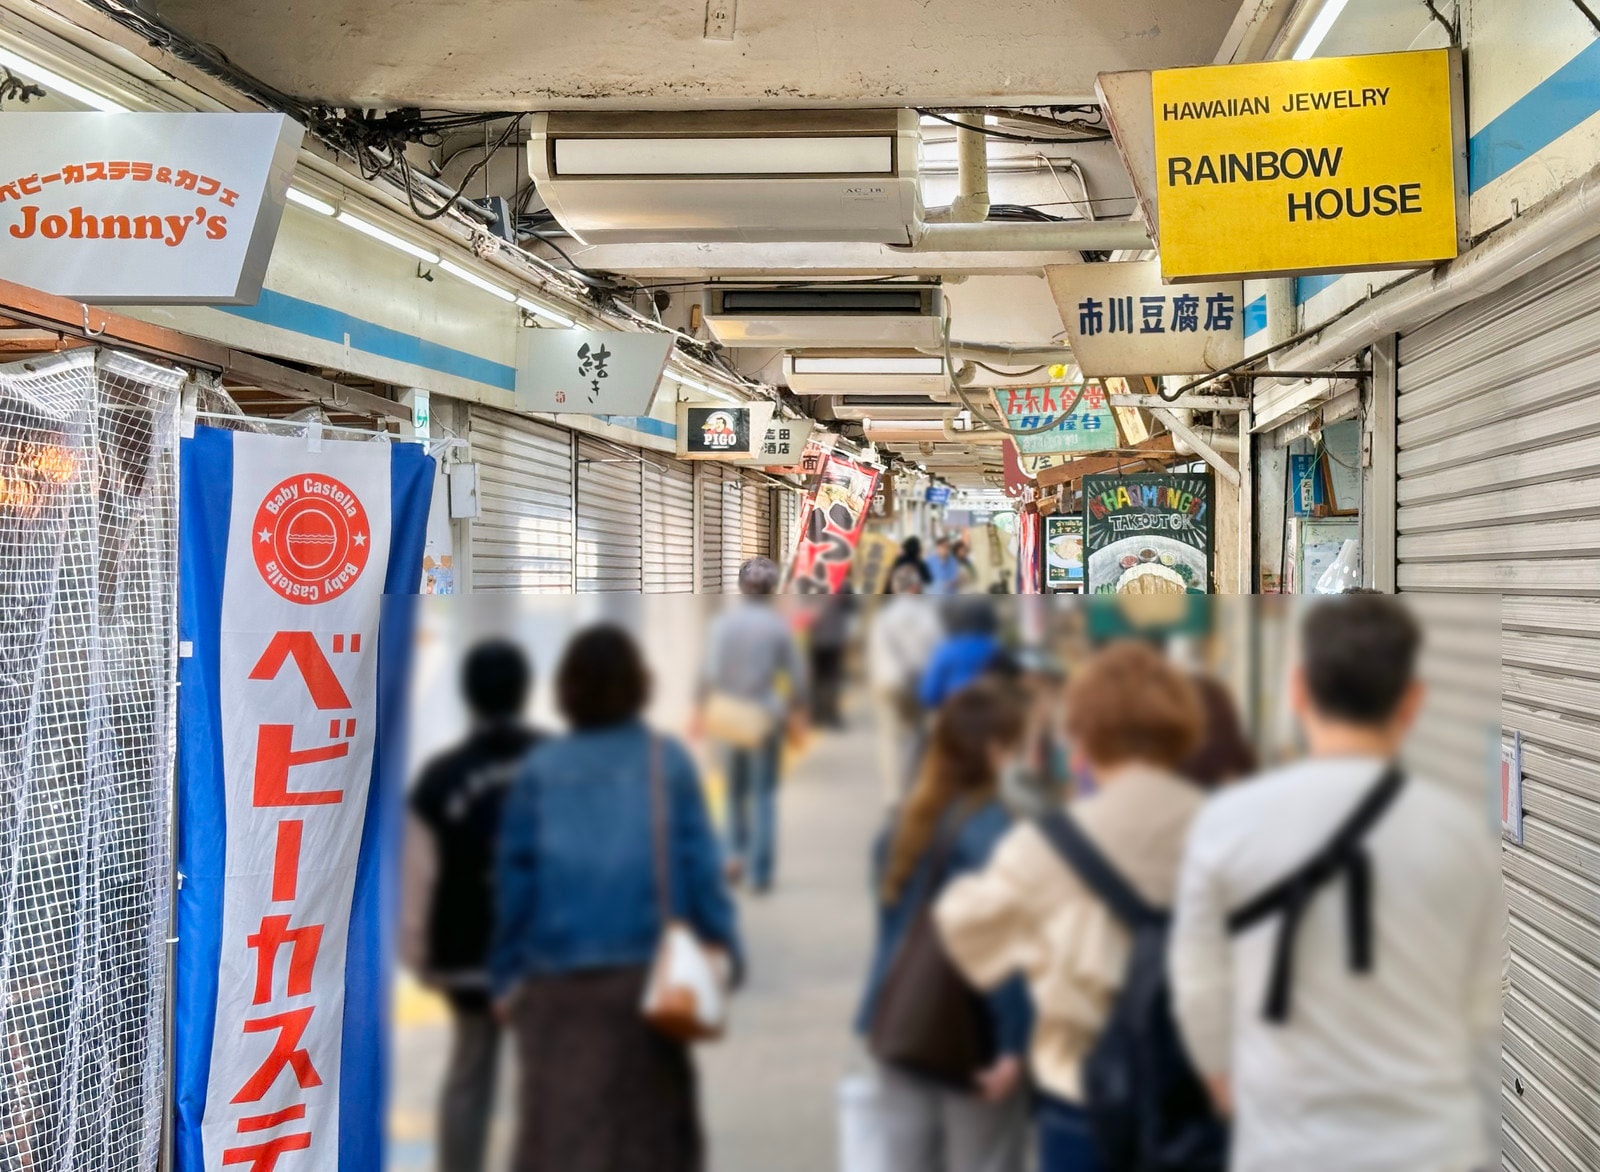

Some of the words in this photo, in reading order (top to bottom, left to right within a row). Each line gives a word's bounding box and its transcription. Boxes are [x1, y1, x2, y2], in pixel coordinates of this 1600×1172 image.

[1163, 96, 1270, 121] HAWAIIAN
[1282, 87, 1391, 112] JEWELRY
[1168, 147, 1343, 186] RAINBOW
[1288, 183, 1422, 222] HOUSE
[9, 206, 227, 247] Johnny's
[1078, 292, 1234, 336] 市川豆腐店
[1006, 386, 1105, 415] 旅人食堂
[703, 433, 737, 446] PIGO
[1020, 413, 1101, 431] タイ屋台
[265, 483, 299, 515] Baby
[303, 478, 357, 518] Castella
[265, 560, 319, 600] Castella
[324, 562, 359, 595] Baby
